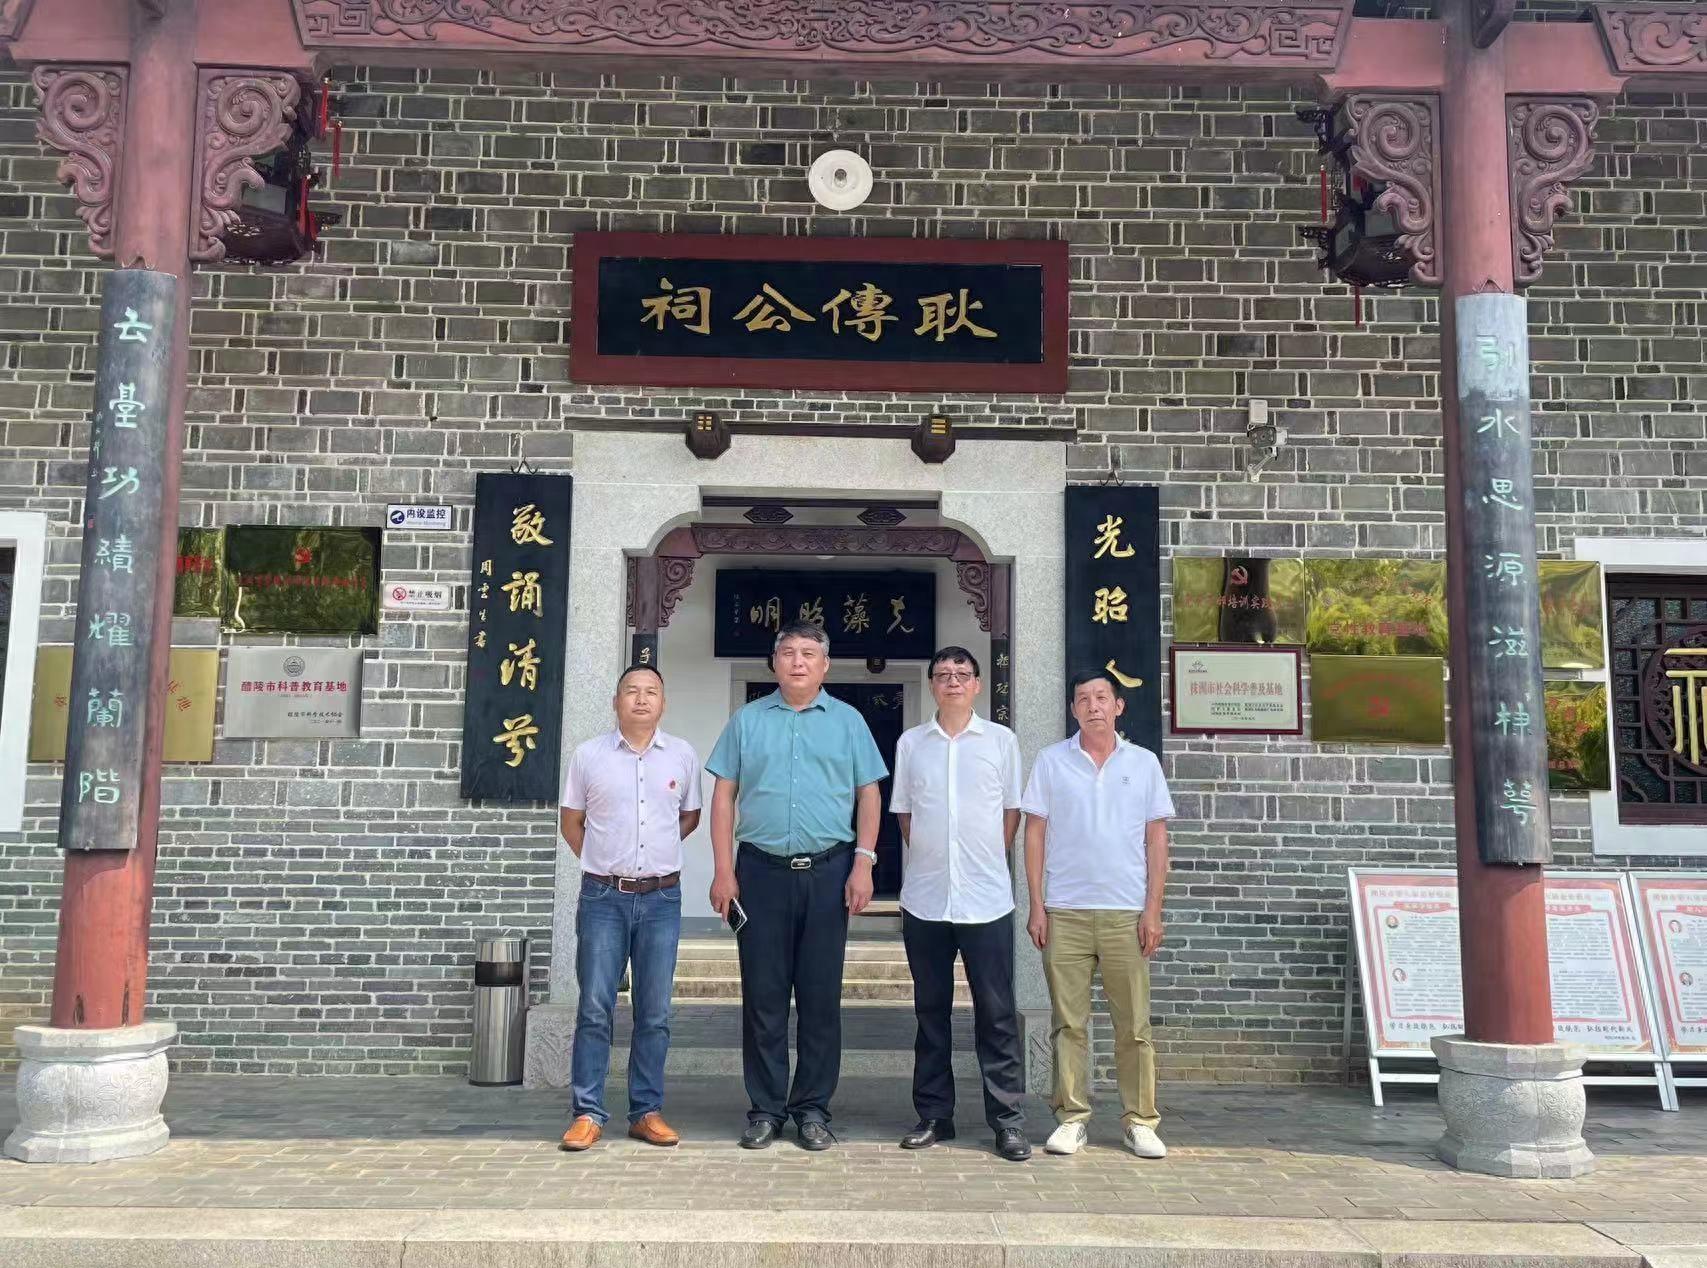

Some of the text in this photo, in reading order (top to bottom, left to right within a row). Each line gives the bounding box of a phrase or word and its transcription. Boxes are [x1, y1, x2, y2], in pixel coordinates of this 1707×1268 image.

[640, 277, 999, 342] 耿傳公祠
[407, 509, 446, 520] 内设监控
[408, 590, 442, 599] 禁止吸烟
[1093, 515, 1144, 742] 光昭人
[241, 680, 349, 693] 醴陵市科普教育基地
